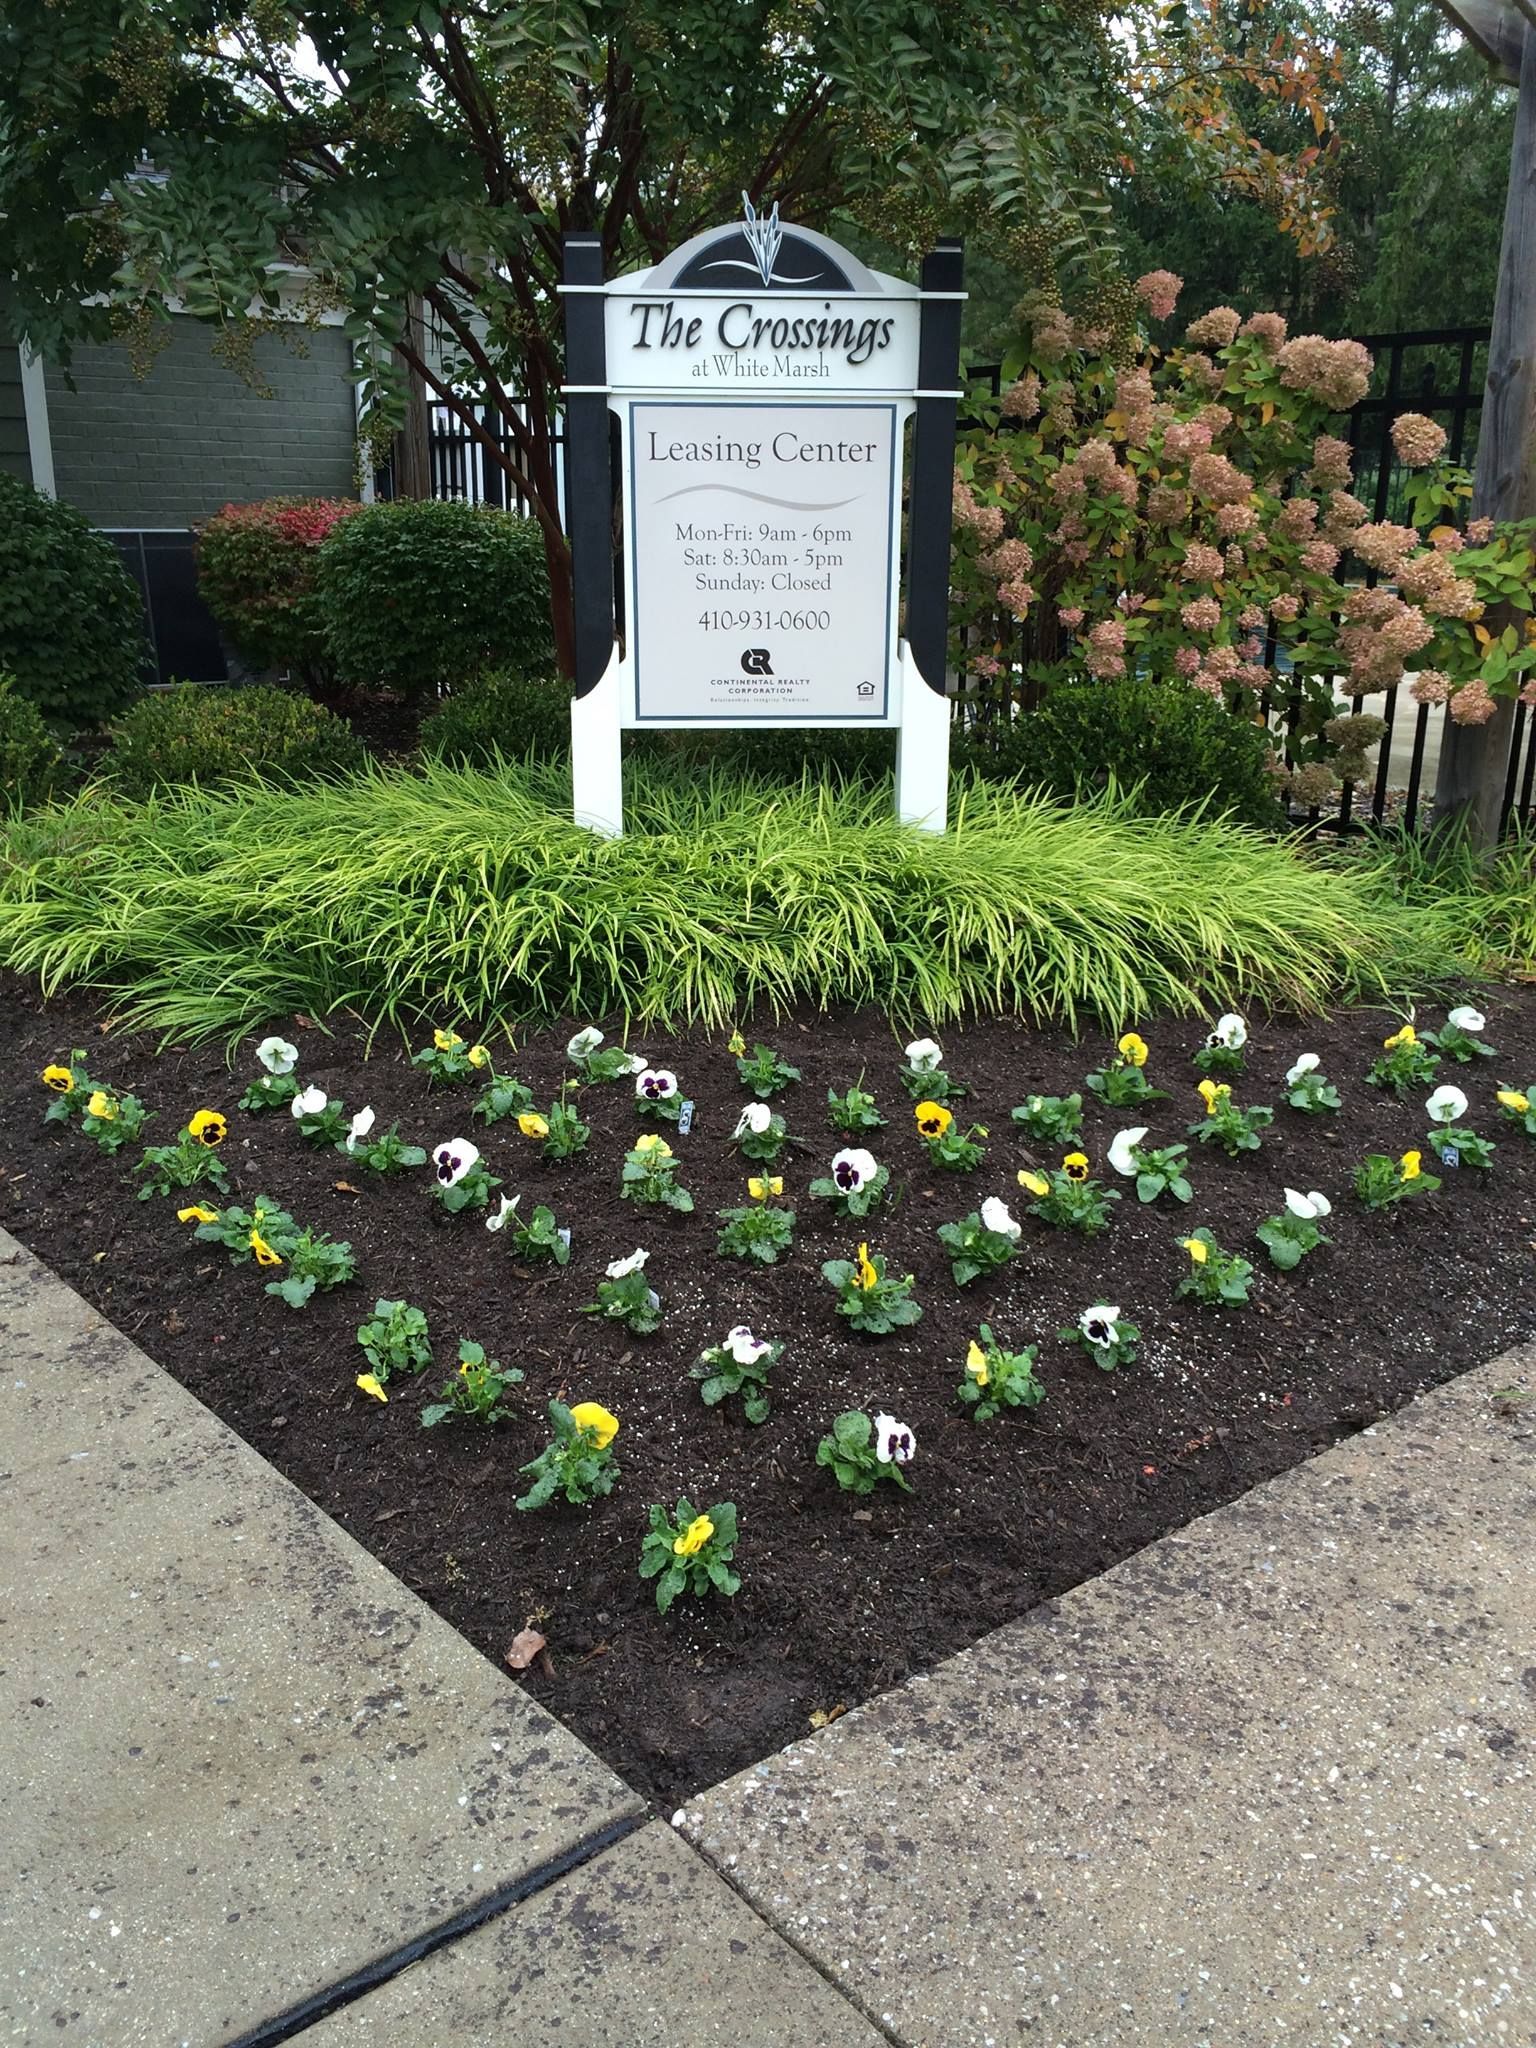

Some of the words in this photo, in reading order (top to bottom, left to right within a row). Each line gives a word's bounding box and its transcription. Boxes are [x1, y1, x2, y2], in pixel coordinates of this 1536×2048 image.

[630, 301, 702, 349] The
[717, 302, 895, 366] Crossings
[691, 359, 709, 377] at
[711, 352, 769, 377] White
[773, 352, 830, 378] Marsh
[648, 431, 761, 469] Leasing
[772, 432, 878, 463] Center
[675, 523, 752, 542] Mon-Fri:
[758, 523, 797, 542] 9am
[812, 523, 853, 546] 6pm
[683, 547, 717, 566] Sat:
[722, 547, 788, 567] 8:30am
[804, 548, 844, 571] 5pm
[695, 571, 765, 594] Sunday:
[771, 571, 832, 591] Closed
[698, 609, 831, 632] 410-931-0600
[728, 687, 793, 695] CORPORATION
